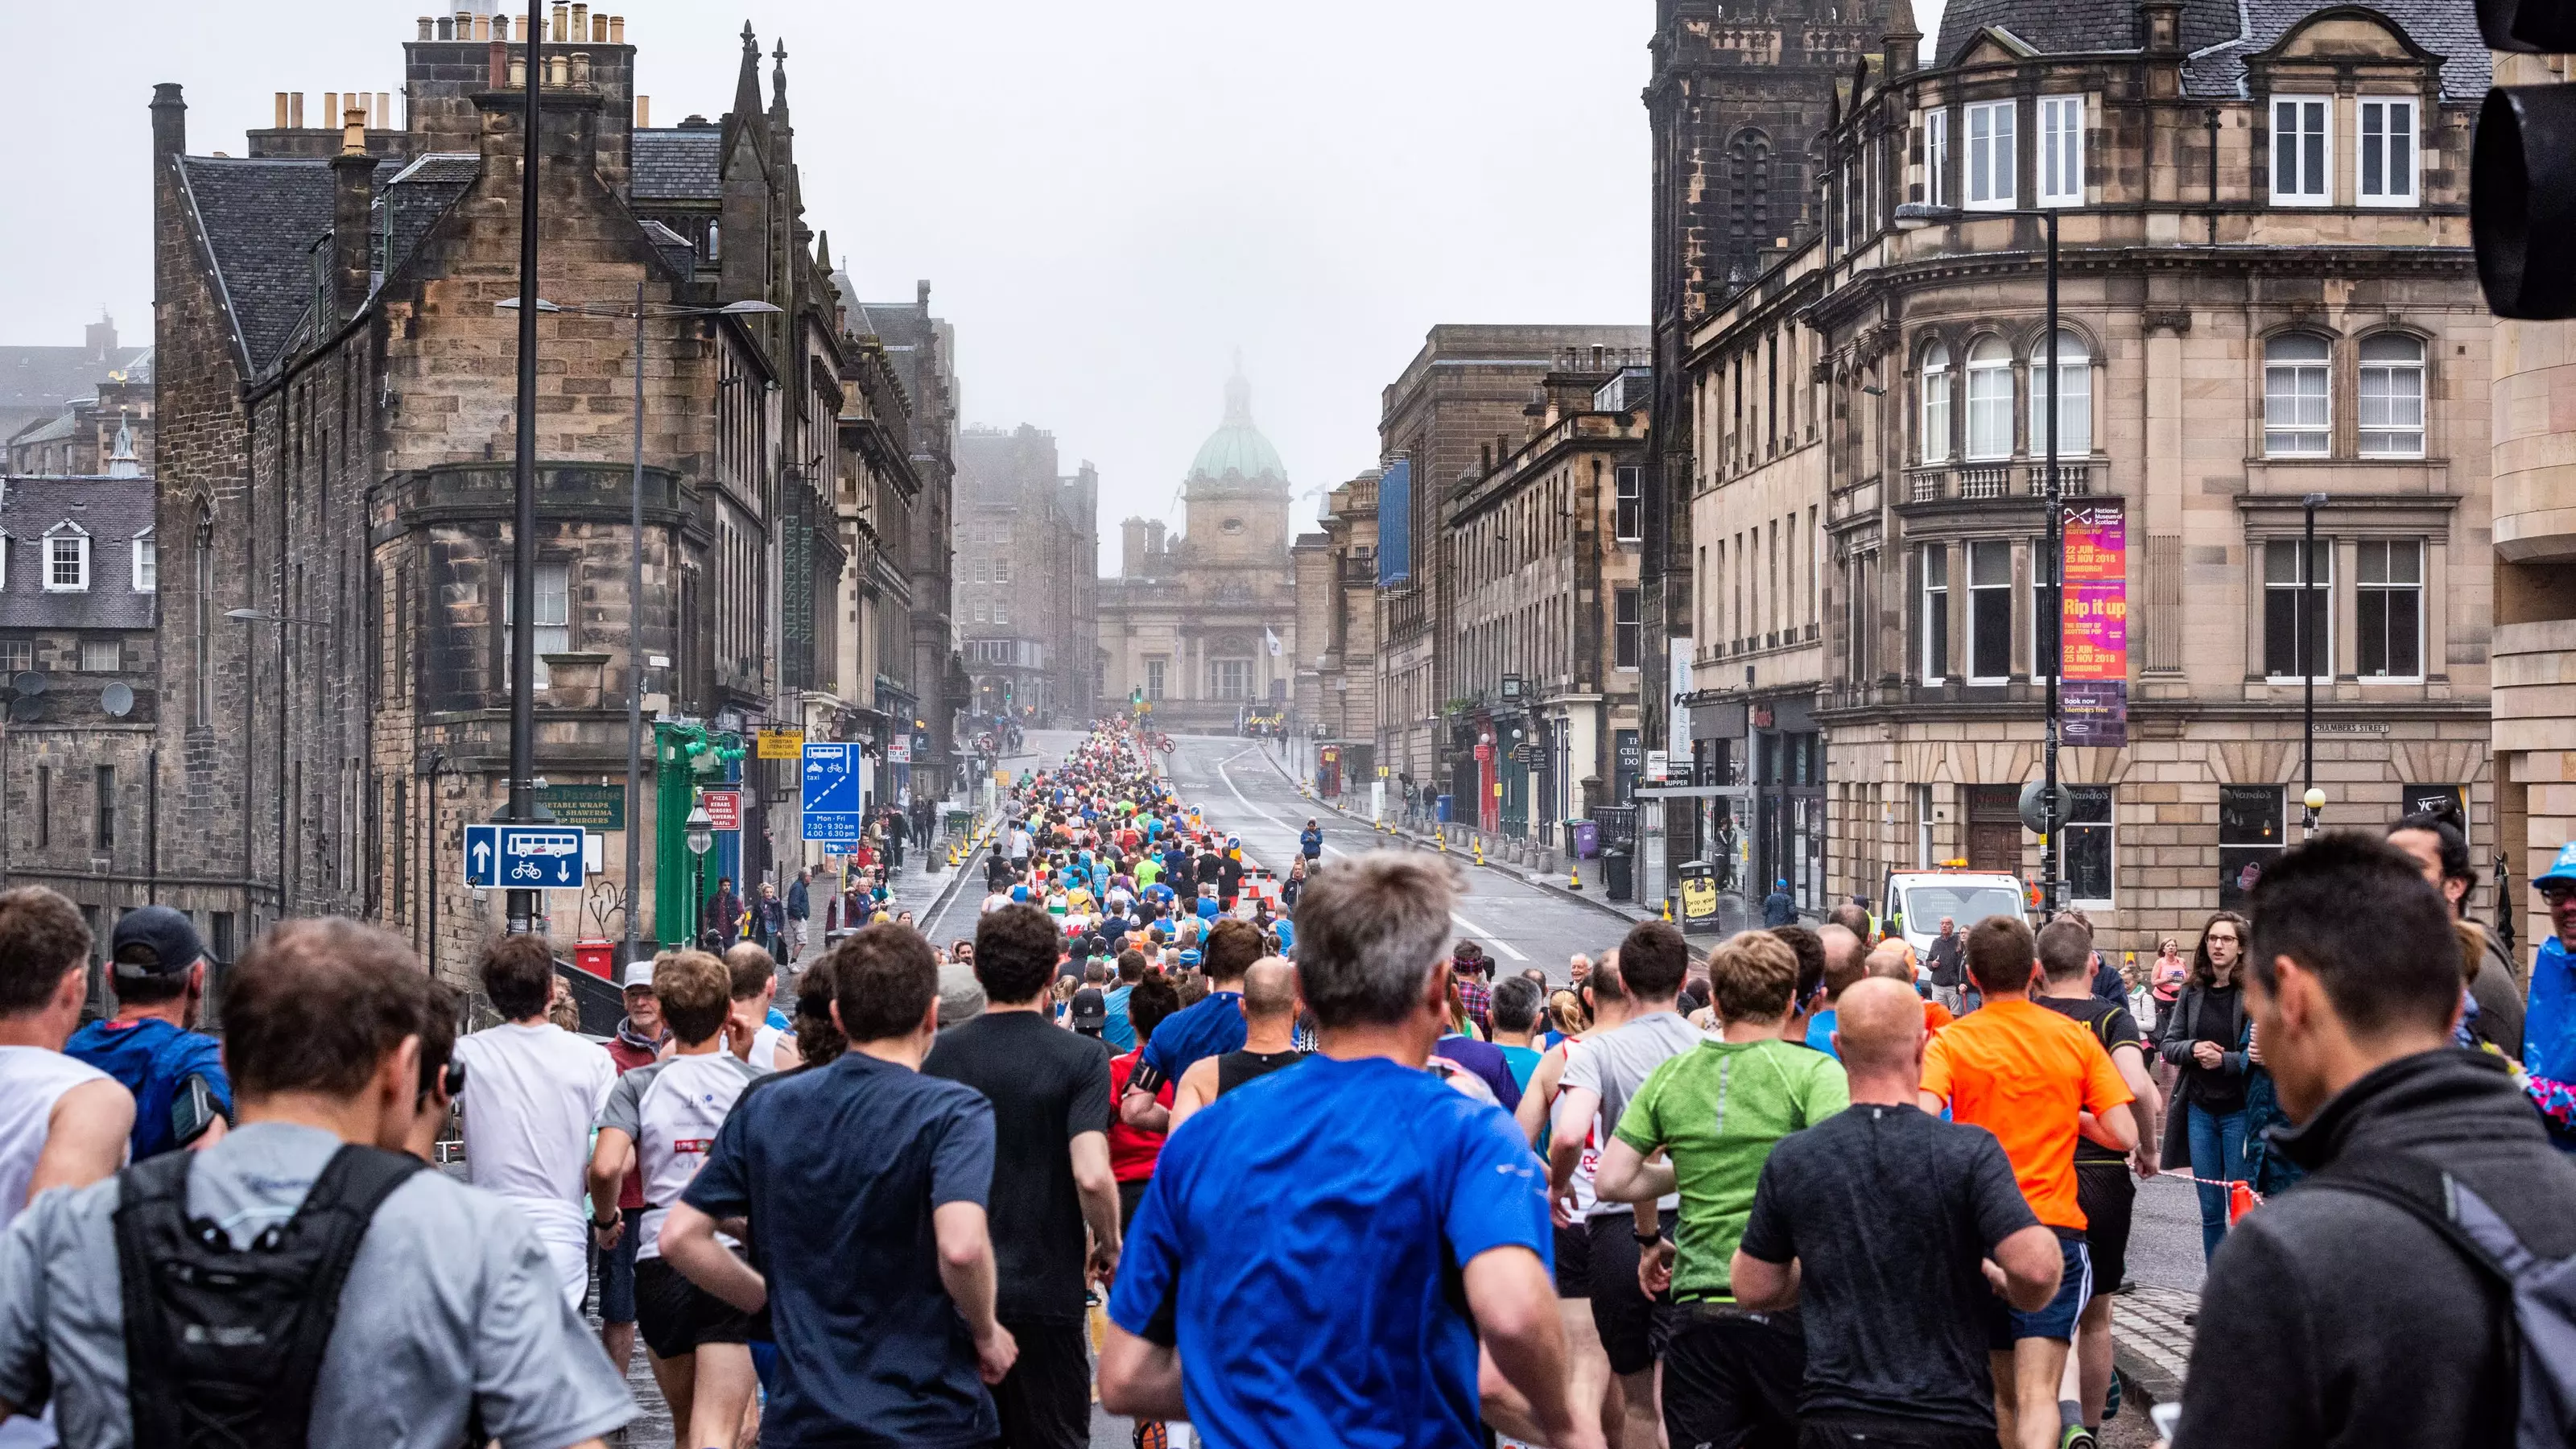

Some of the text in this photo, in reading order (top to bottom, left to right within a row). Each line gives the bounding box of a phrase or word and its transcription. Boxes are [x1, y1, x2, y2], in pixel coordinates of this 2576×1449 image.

[2066, 546, 2075, 554] 22
[2077, 546, 2093, 554] JUN
[2066, 554, 2116, 563] 25 NOV 2018
[784, 515, 799, 639] FRANKENSTEIN
[801, 527, 813, 645] FRANKENSTEIN
[2064, 599, 2126, 618] Rip it up
[2064, 654, 2116, 663] 25 NOV 2018
[2070, 790, 2108, 800] Nando's
[2231, 789, 2272, 799] Nando's
